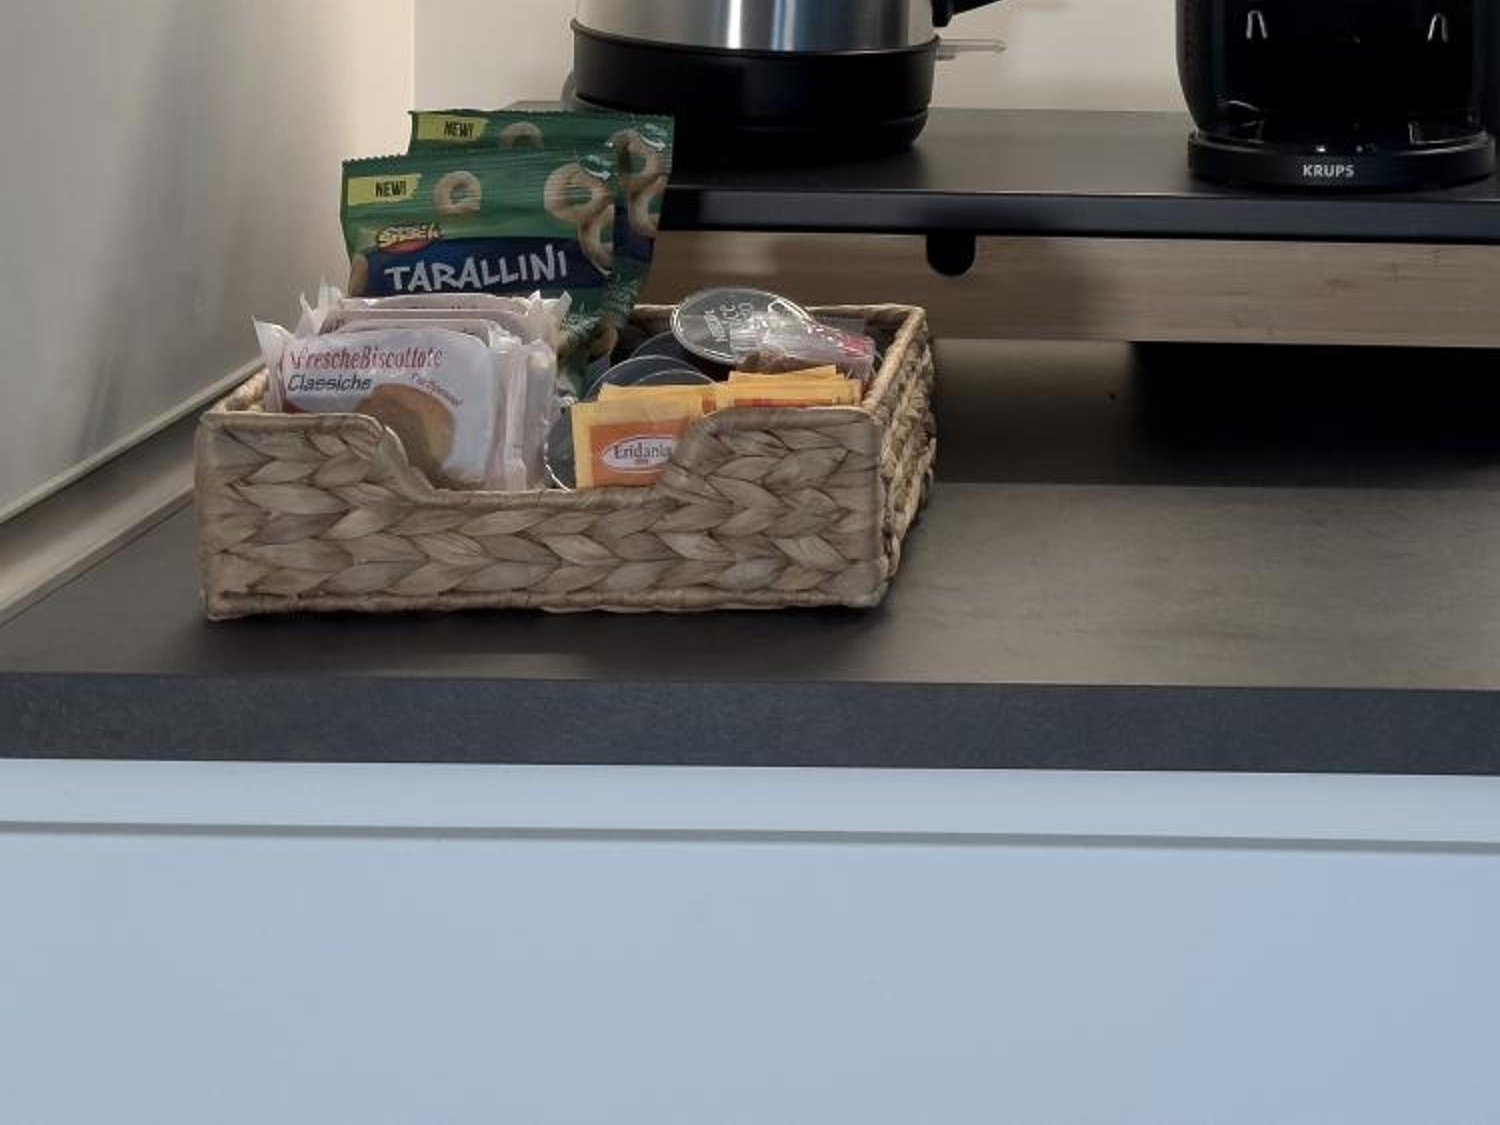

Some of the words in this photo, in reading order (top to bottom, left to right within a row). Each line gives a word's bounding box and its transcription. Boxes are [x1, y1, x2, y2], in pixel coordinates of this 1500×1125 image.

[443, 121, 475, 138] NEW!
[1302, 164, 1355, 178] KRUPS
[374, 180, 407, 198] NEW!
[383, 244, 568, 292] TARALLINI
[287, 374, 373, 392] Classiche
